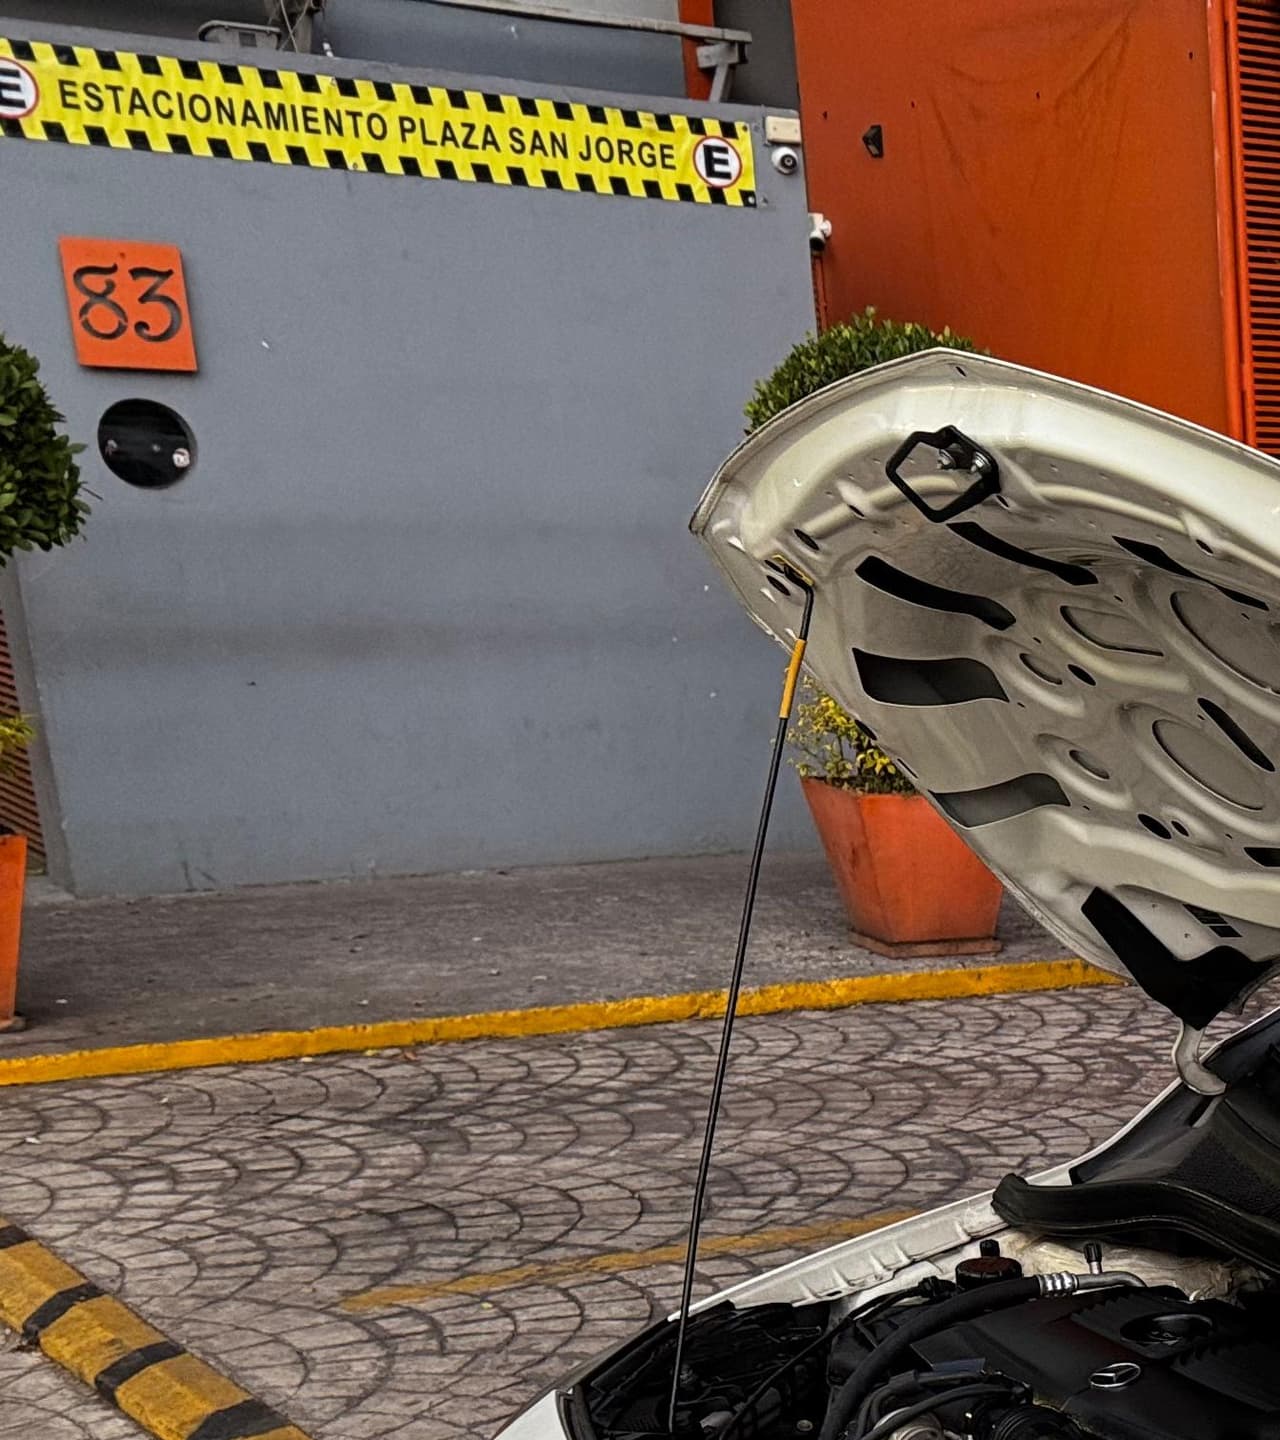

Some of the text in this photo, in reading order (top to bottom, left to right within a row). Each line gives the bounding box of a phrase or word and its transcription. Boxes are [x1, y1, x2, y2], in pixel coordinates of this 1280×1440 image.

[58, 79, 388, 140] ESTACIONAMIENTO
[399, 115, 501, 153] PLAZA
[509, 127, 570, 160] SAN
[578, 135, 677, 170] JORGE
[73, 262, 182, 342] 83
